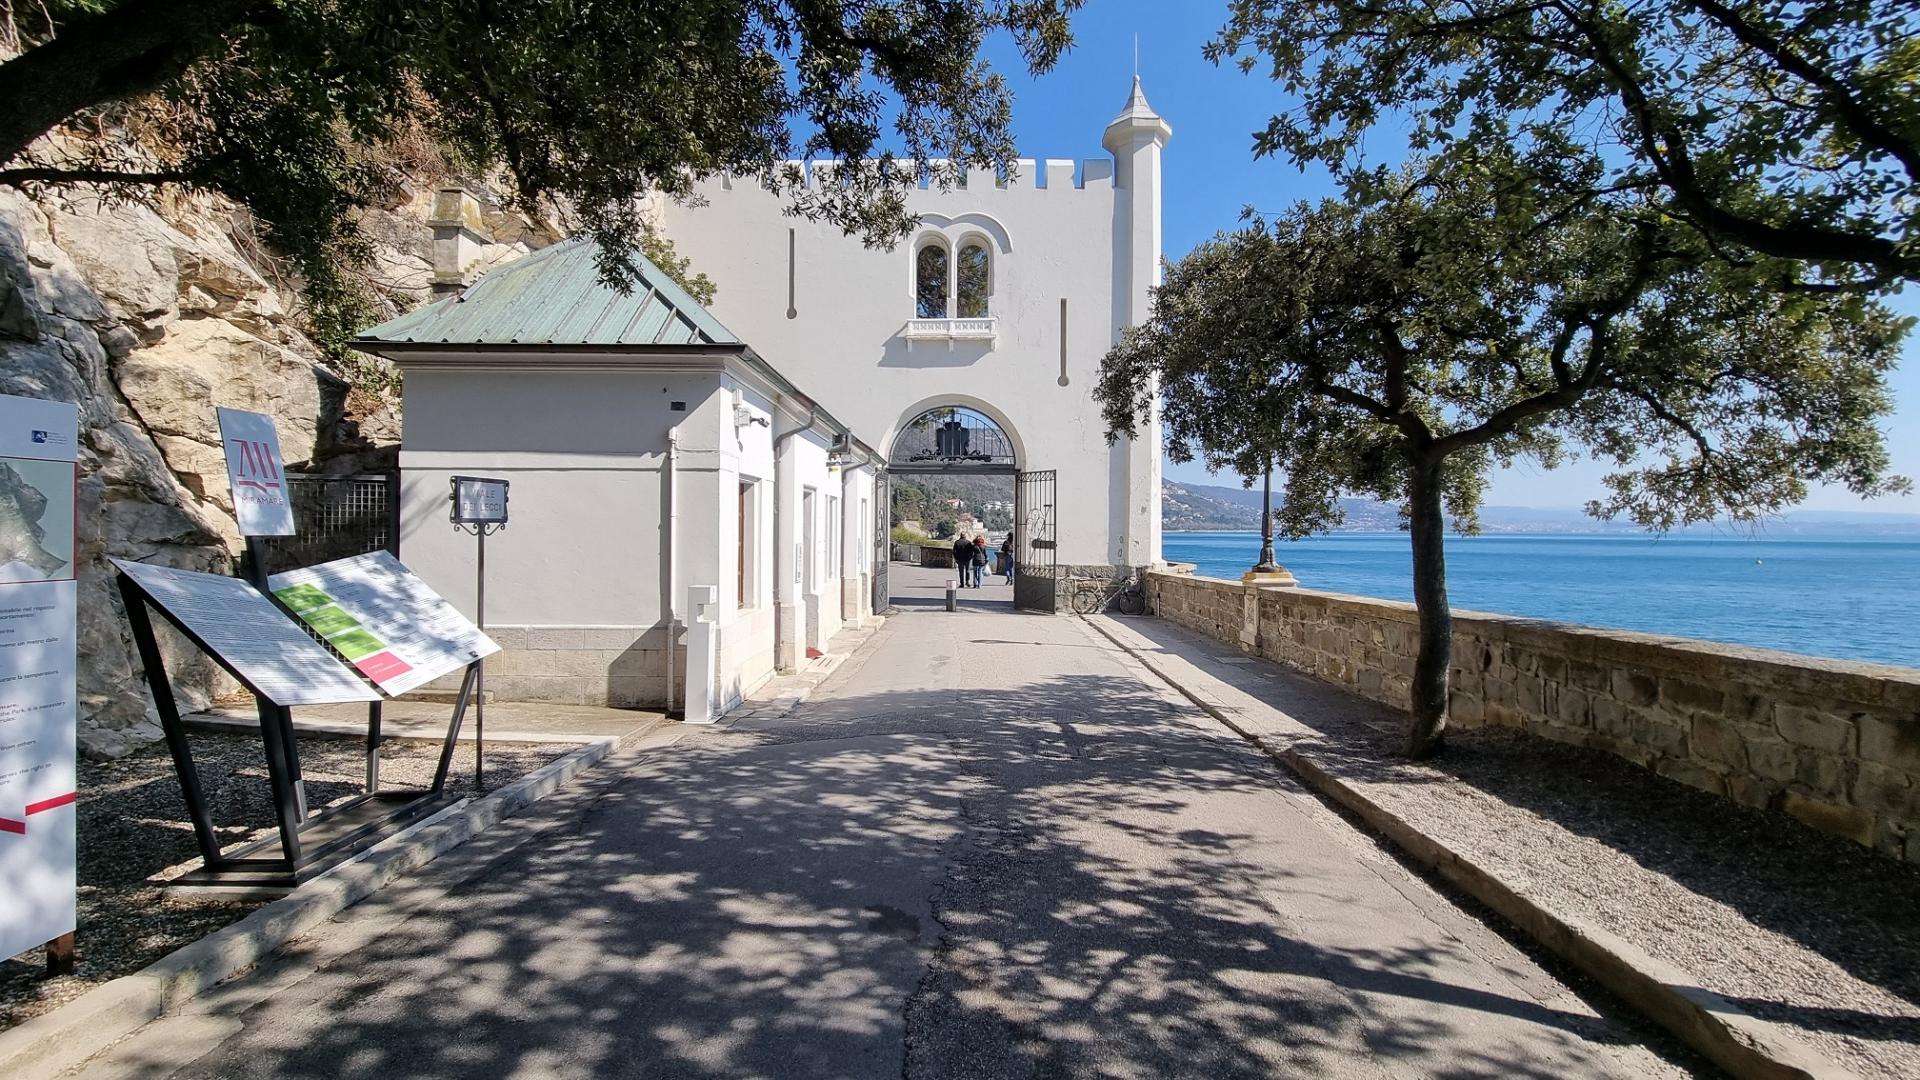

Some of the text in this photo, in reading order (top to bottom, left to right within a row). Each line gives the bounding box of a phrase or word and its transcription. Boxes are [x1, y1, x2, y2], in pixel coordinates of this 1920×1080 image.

[472, 488, 496, 499] VIALE
[241, 496, 285, 506] MIRAMARE
[463, 502, 502, 512] DEI LECCI
